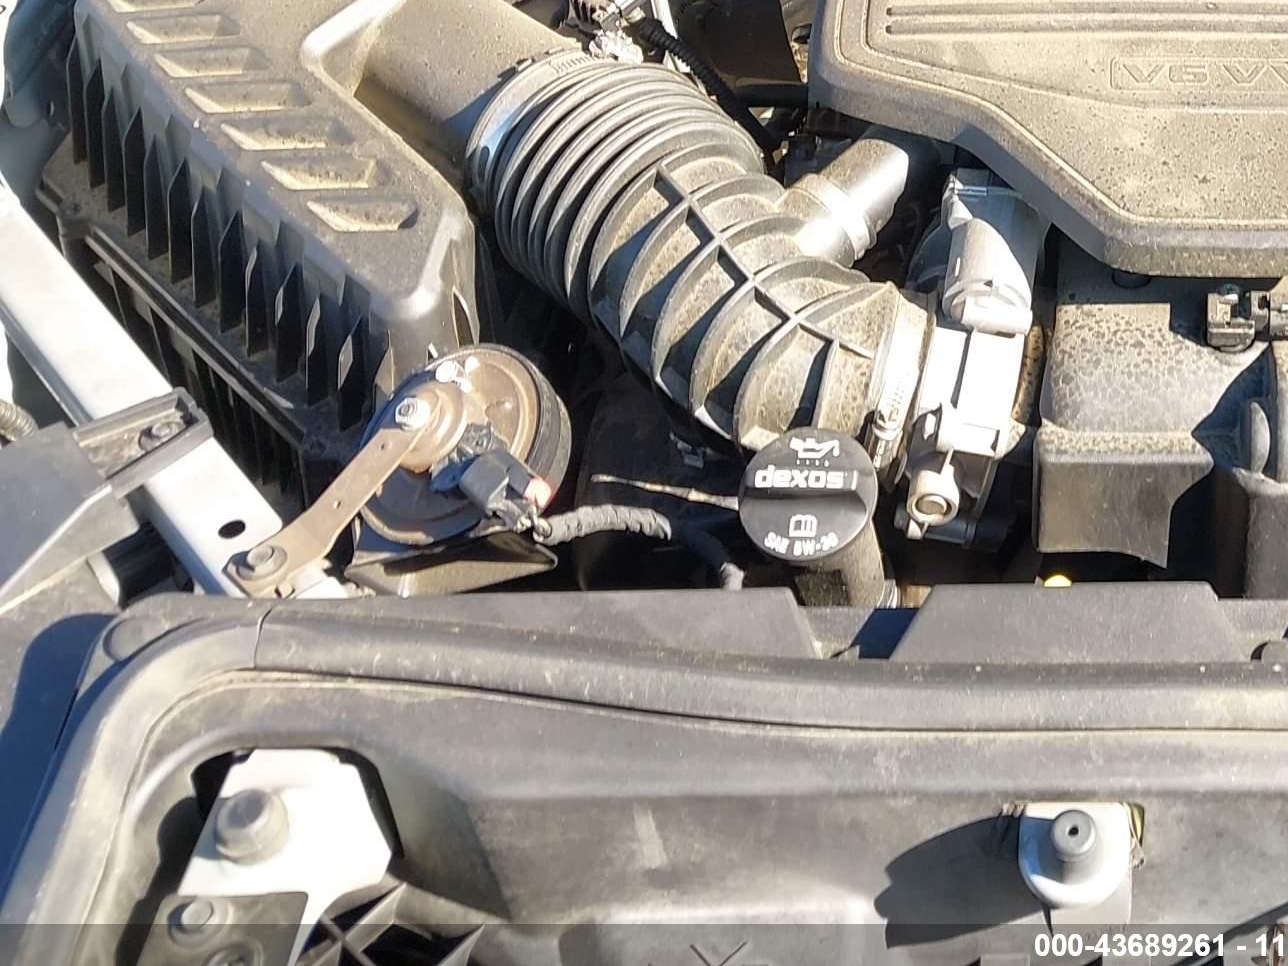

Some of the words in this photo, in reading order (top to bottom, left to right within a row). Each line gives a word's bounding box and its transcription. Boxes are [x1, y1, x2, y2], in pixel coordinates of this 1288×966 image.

[1122, 63, 1209, 84] V6
[754, 465, 844, 489] dexos
[764, 531, 790, 554] SAE
